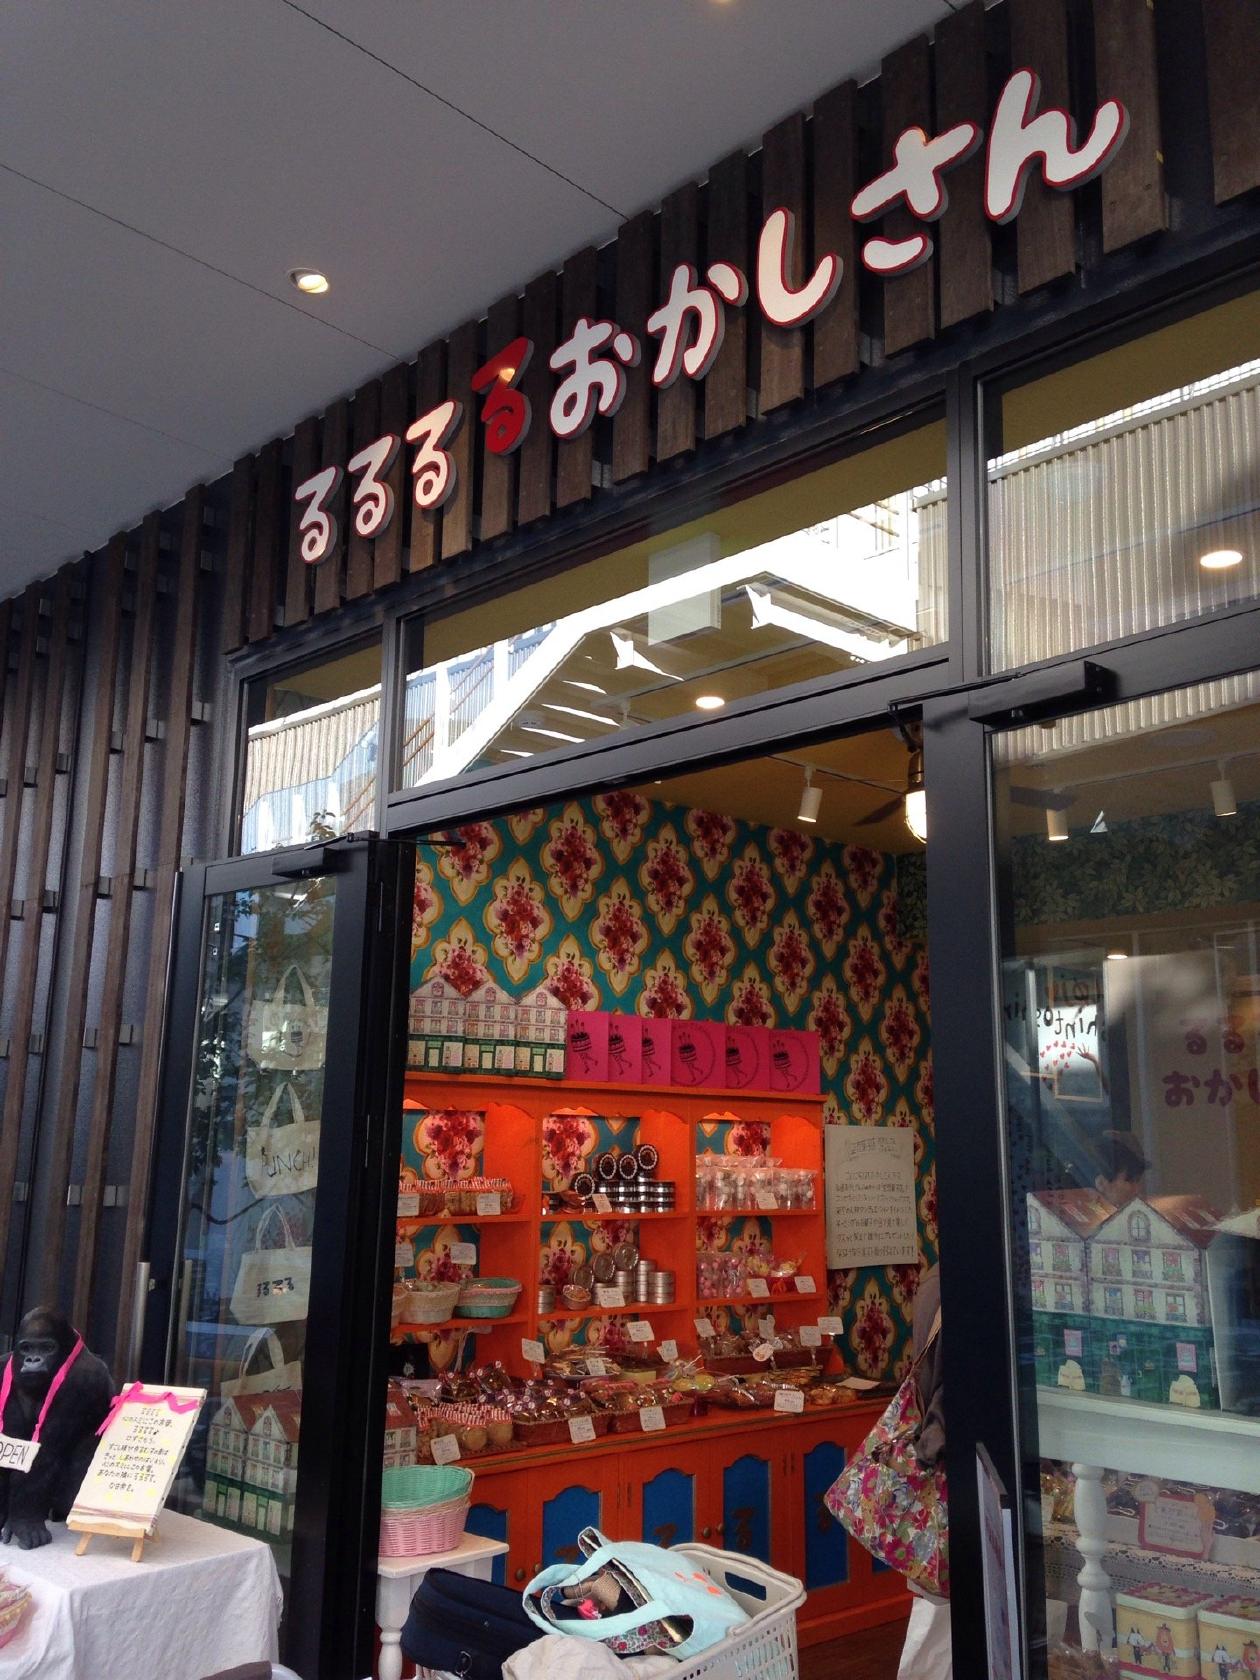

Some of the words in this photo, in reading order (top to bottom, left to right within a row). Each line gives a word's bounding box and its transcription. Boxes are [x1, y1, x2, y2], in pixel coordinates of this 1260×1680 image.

[296, 68, 1129, 563] るるるるおかしさん
